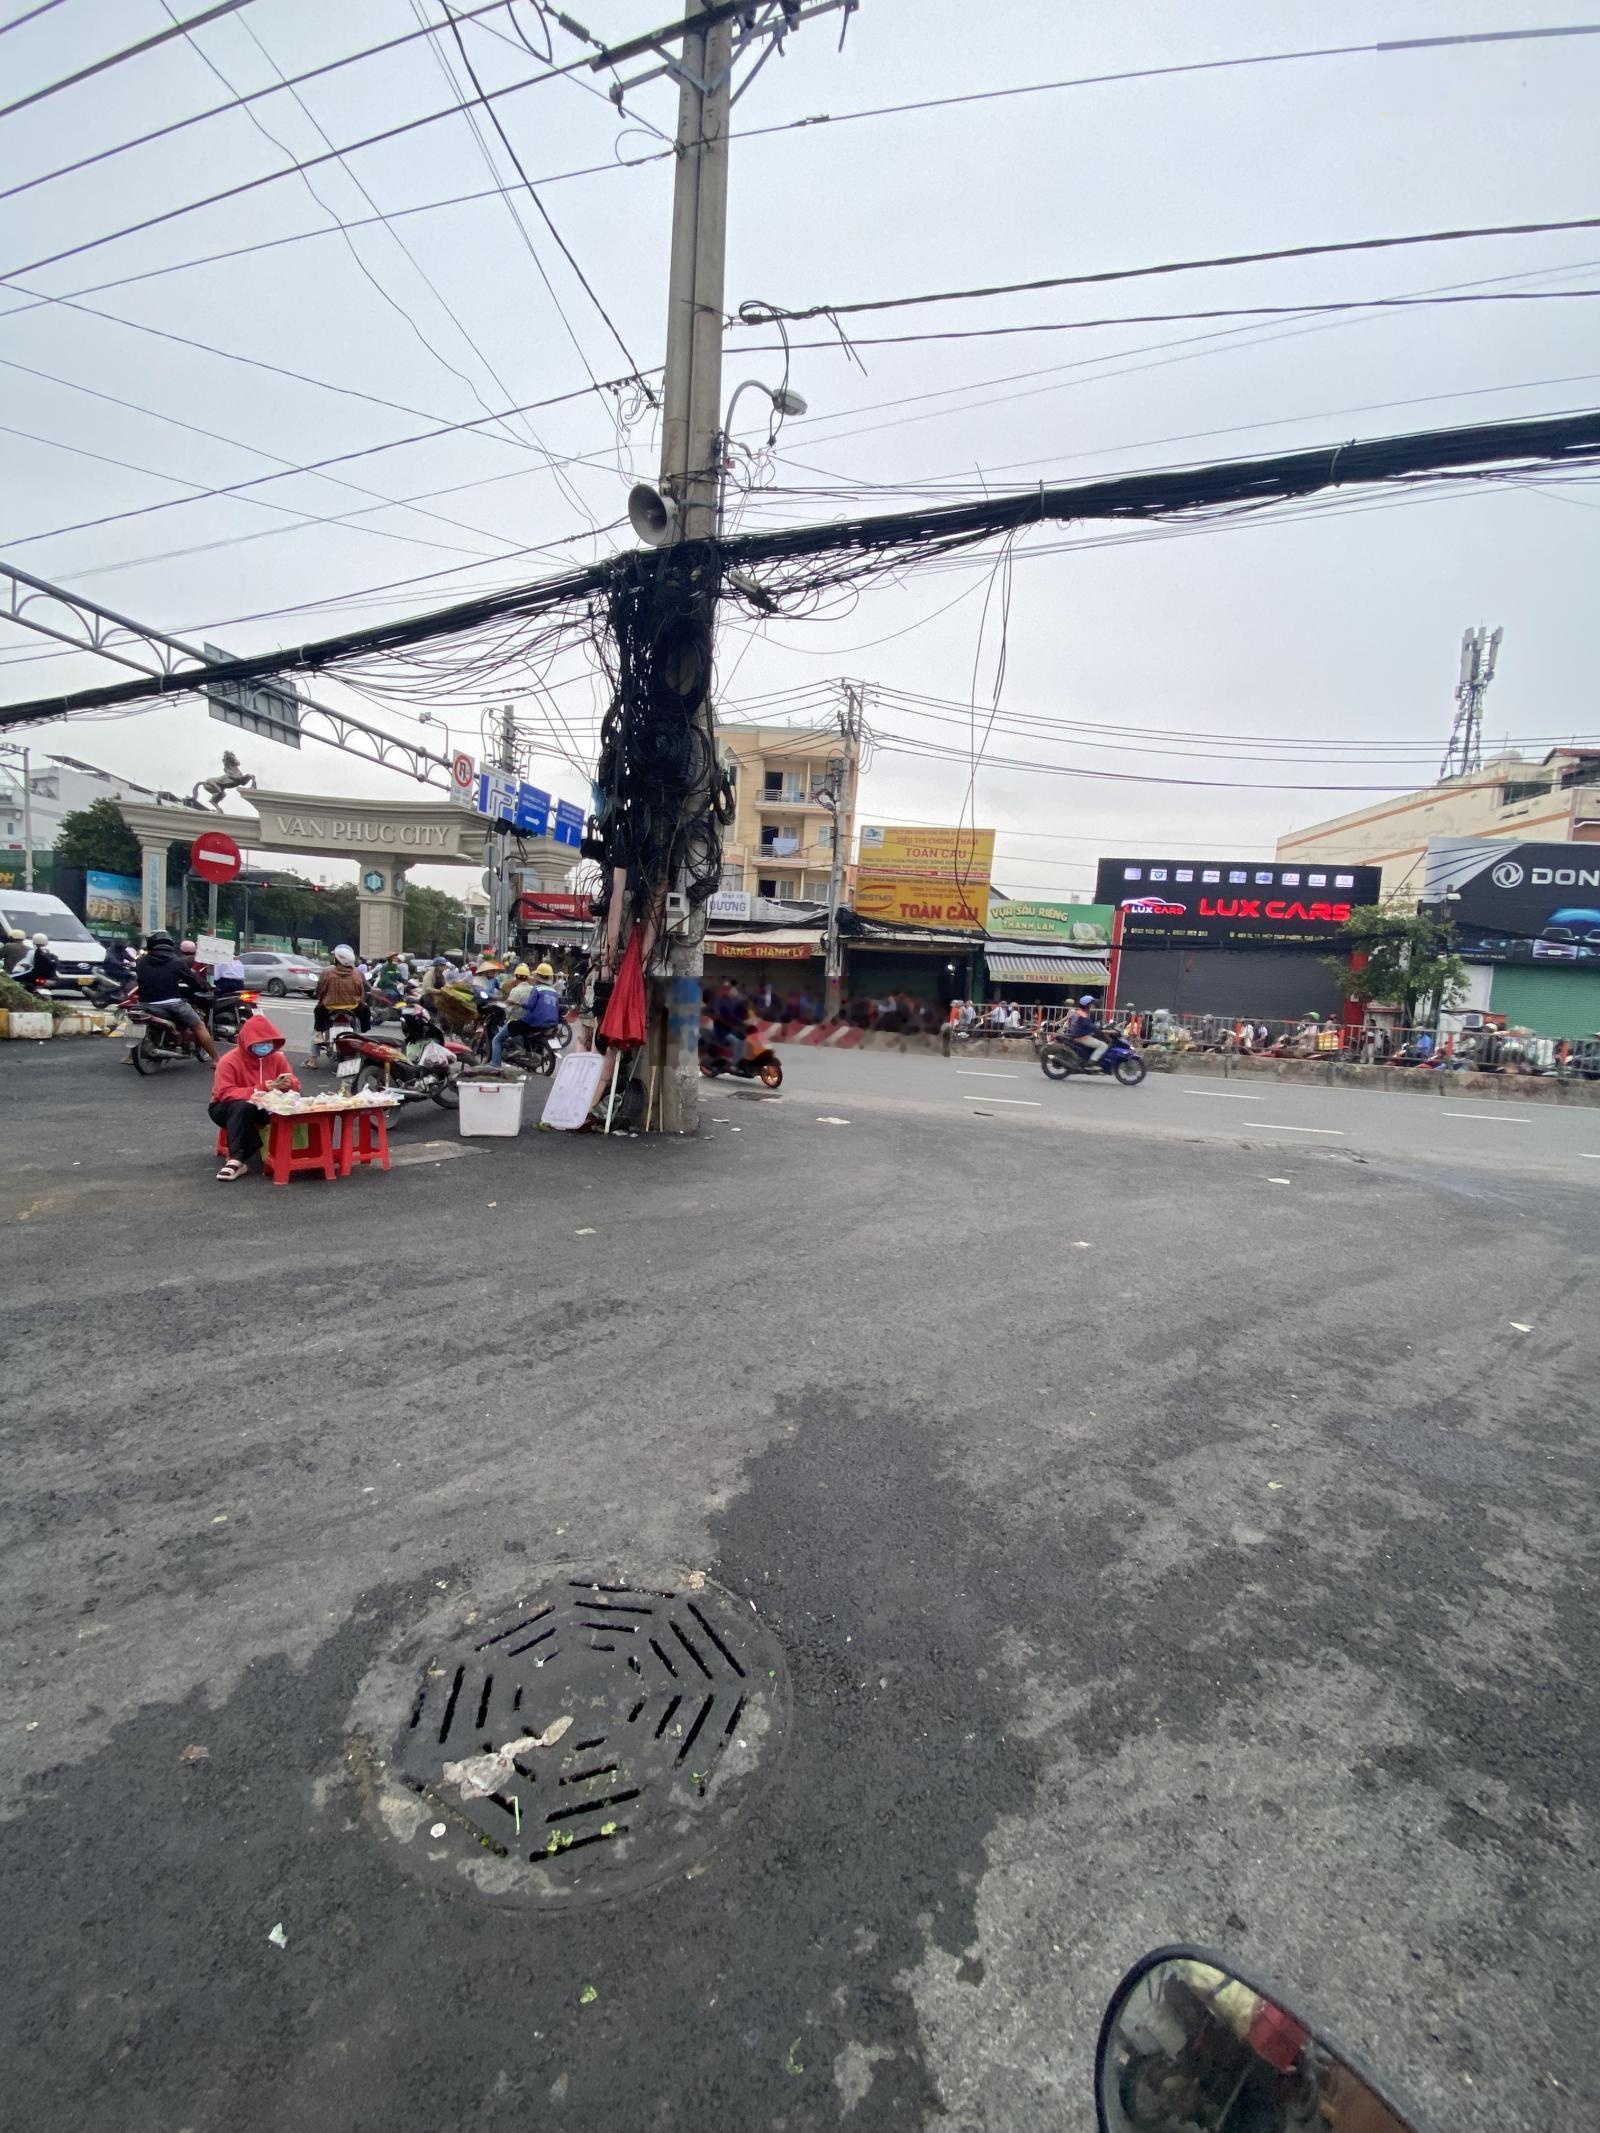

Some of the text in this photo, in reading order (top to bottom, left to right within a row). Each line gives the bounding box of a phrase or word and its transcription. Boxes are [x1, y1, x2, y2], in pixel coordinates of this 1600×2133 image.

[277, 816, 449, 846] VAN PHUC CITY
[1531, 868, 1600, 886] DON
[1131, 905, 1185, 915] LUX CARS
[1199, 897, 1352, 921] LUX CARS
